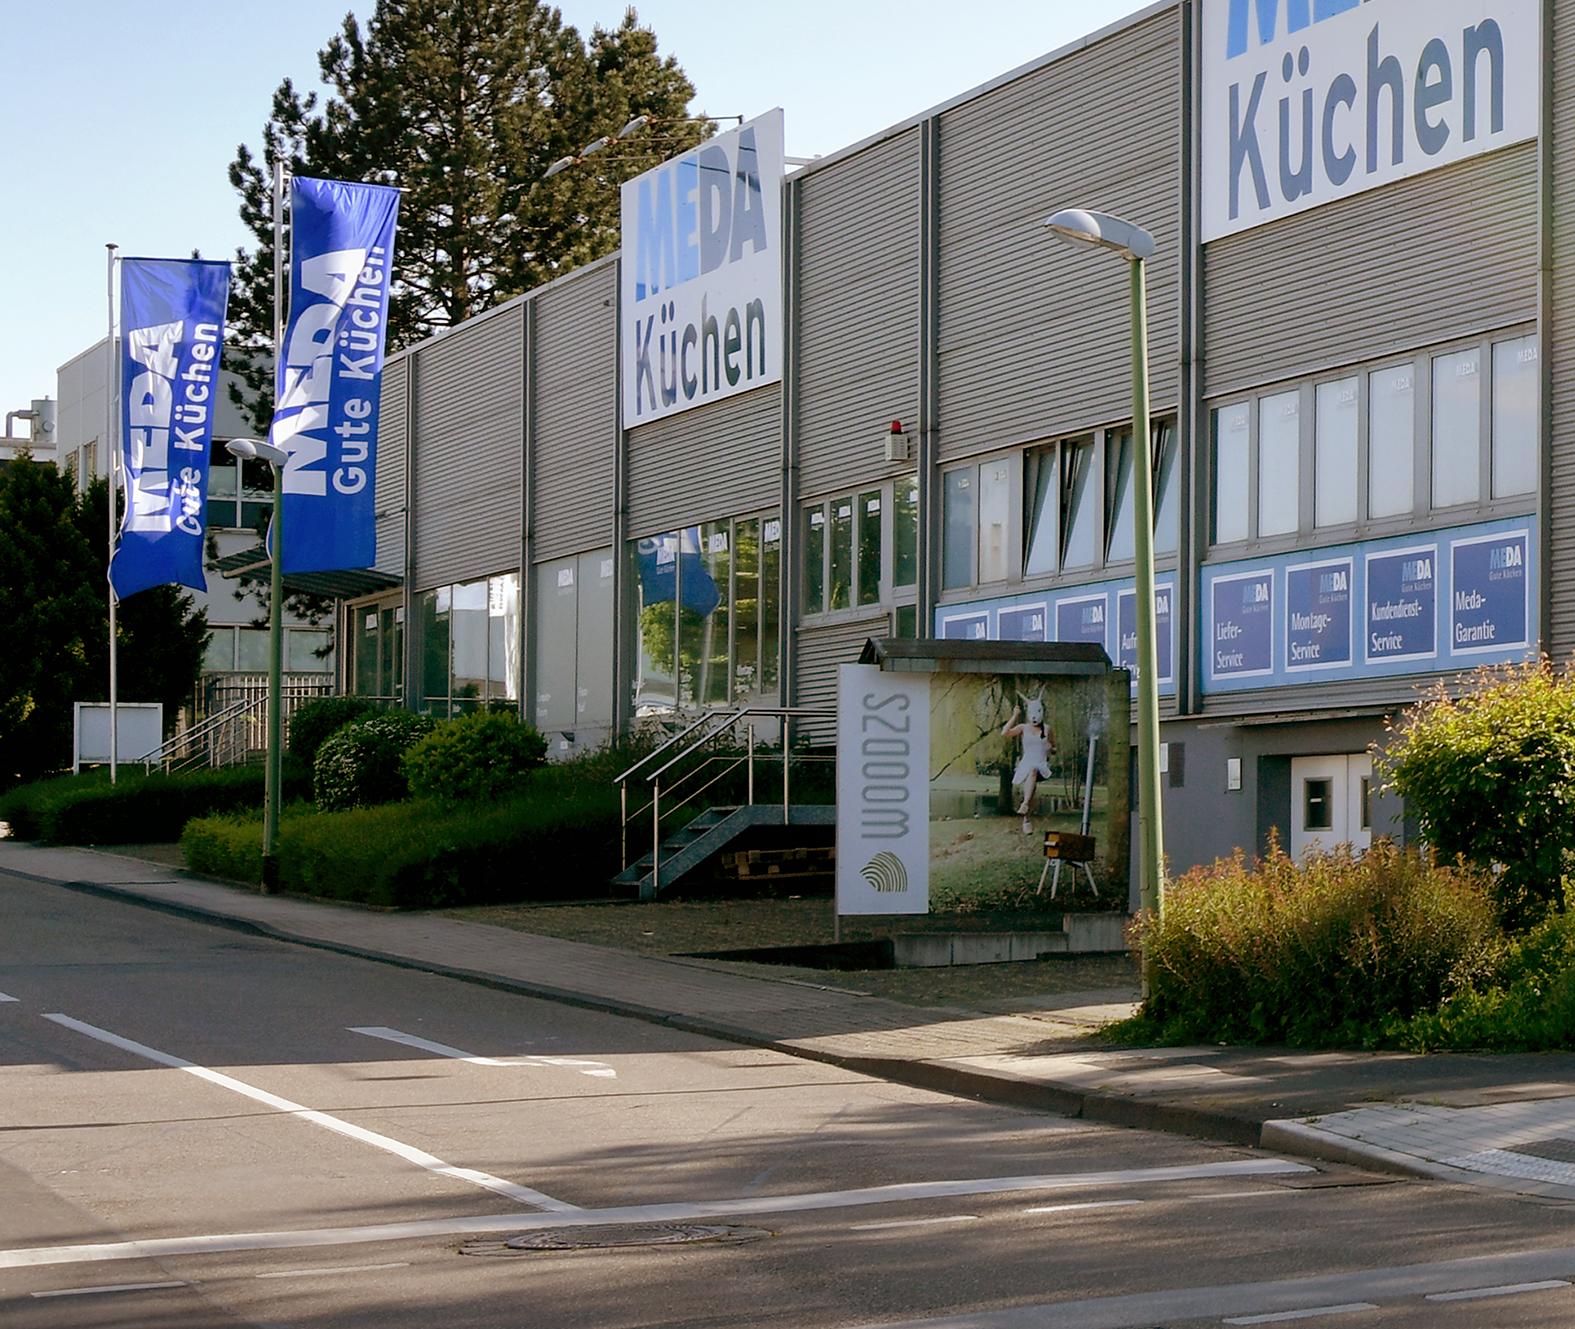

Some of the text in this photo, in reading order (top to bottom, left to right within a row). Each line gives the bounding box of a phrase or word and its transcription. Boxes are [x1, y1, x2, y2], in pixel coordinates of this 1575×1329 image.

[1228, 17, 1504, 220] Küchen
[636, 126, 767, 302] MEDA
[636, 291, 765, 416] Küchen
[272, 248, 366, 496] MEDA
[333, 246, 385, 495] Gute Küchen
[126, 320, 183, 532] MEDA
[173, 324, 219, 535] Gute Küchen
[1490, 544, 1522, 569] MEDA
[1320, 571, 1347, 593] MEDA
[1401, 559, 1431, 582] MEDA
[1243, 583, 1268, 603] MEDA
[1455, 591, 1486, 611] Meda-
[1371, 599, 1422, 622] Kundendienst-
[1216, 622, 1242, 642] Liefer-
[1291, 612, 1331, 634] Montage-
[1455, 622, 1496, 642] Garantie
[1291, 641, 1321, 661] Service
[1371, 632, 1403, 652] Service
[1216, 651, 1243, 669] Service
[861, 693, 910, 839] WOODZS
